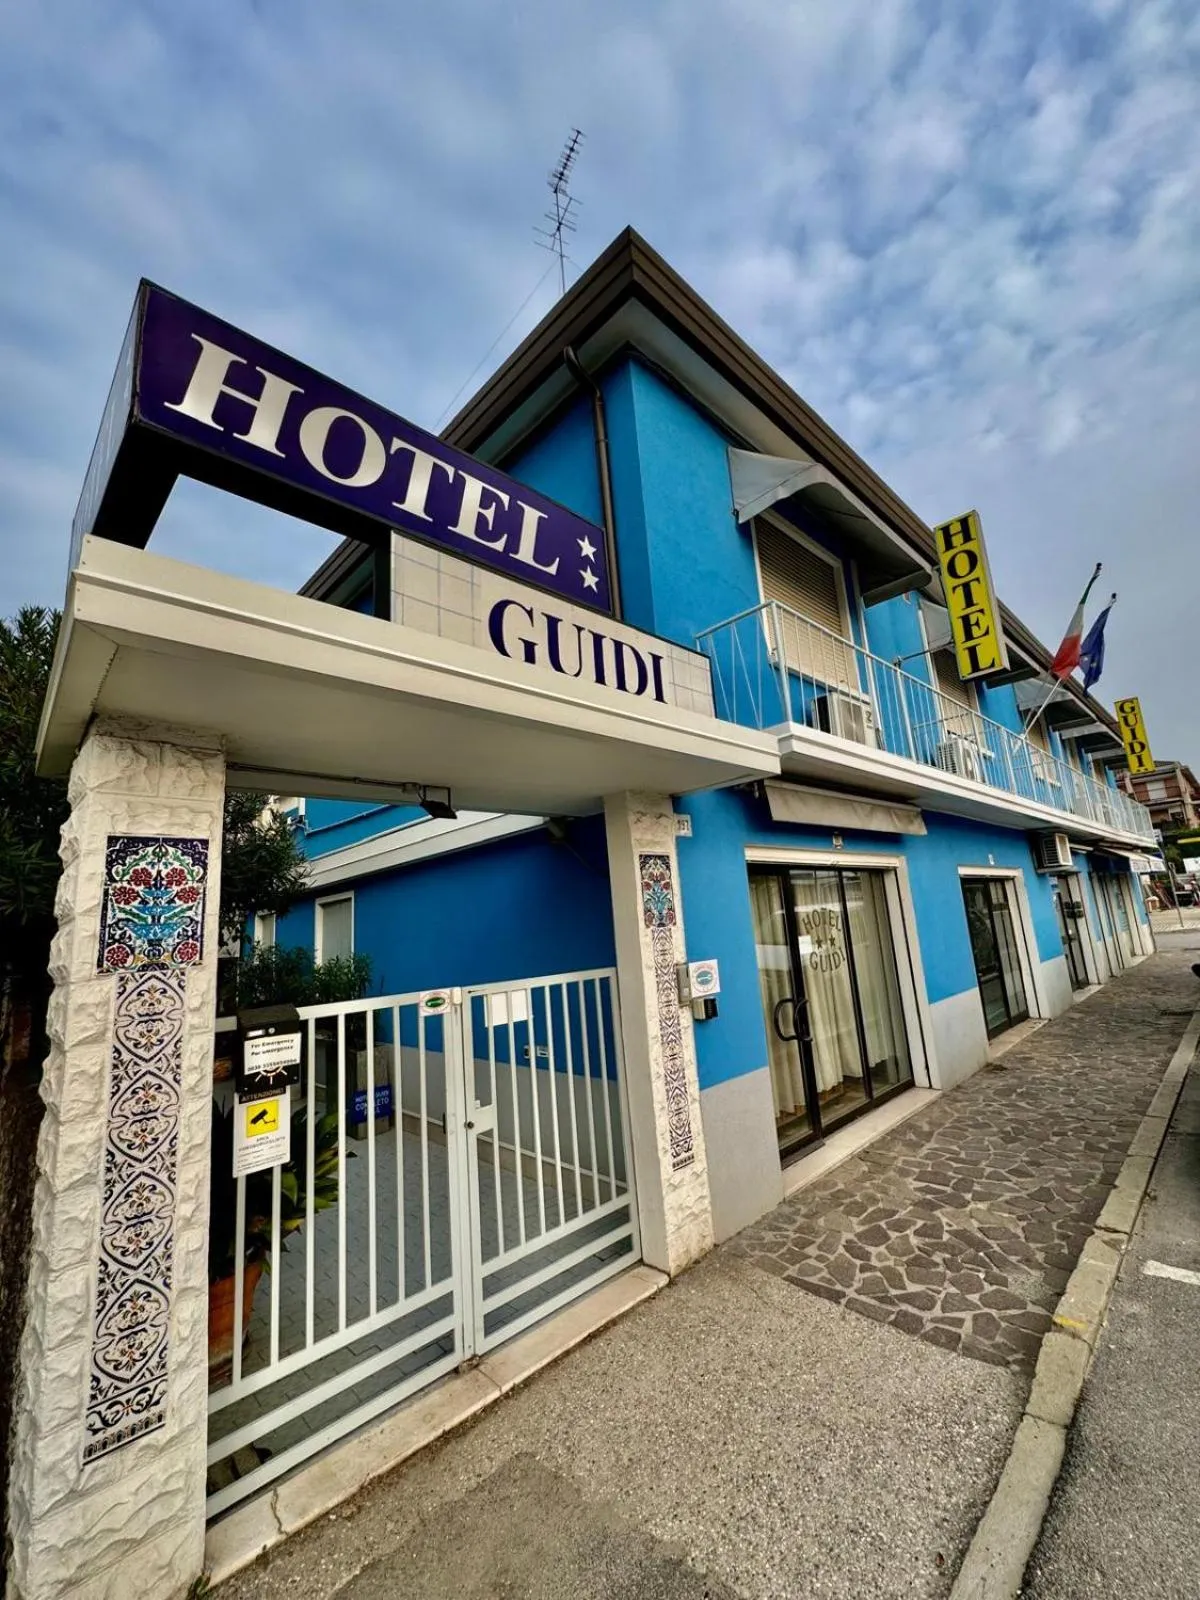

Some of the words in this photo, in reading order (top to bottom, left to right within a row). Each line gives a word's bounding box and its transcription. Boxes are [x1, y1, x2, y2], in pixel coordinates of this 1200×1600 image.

[163, 332, 561, 576] HOTEL
[939, 514, 996, 675] HOTEL
[487, 598, 668, 705] GUIDI
[1118, 701, 1147, 768] GUIDI
[801, 907, 842, 934] HOTEL
[808, 947, 846, 973] GUIDI
